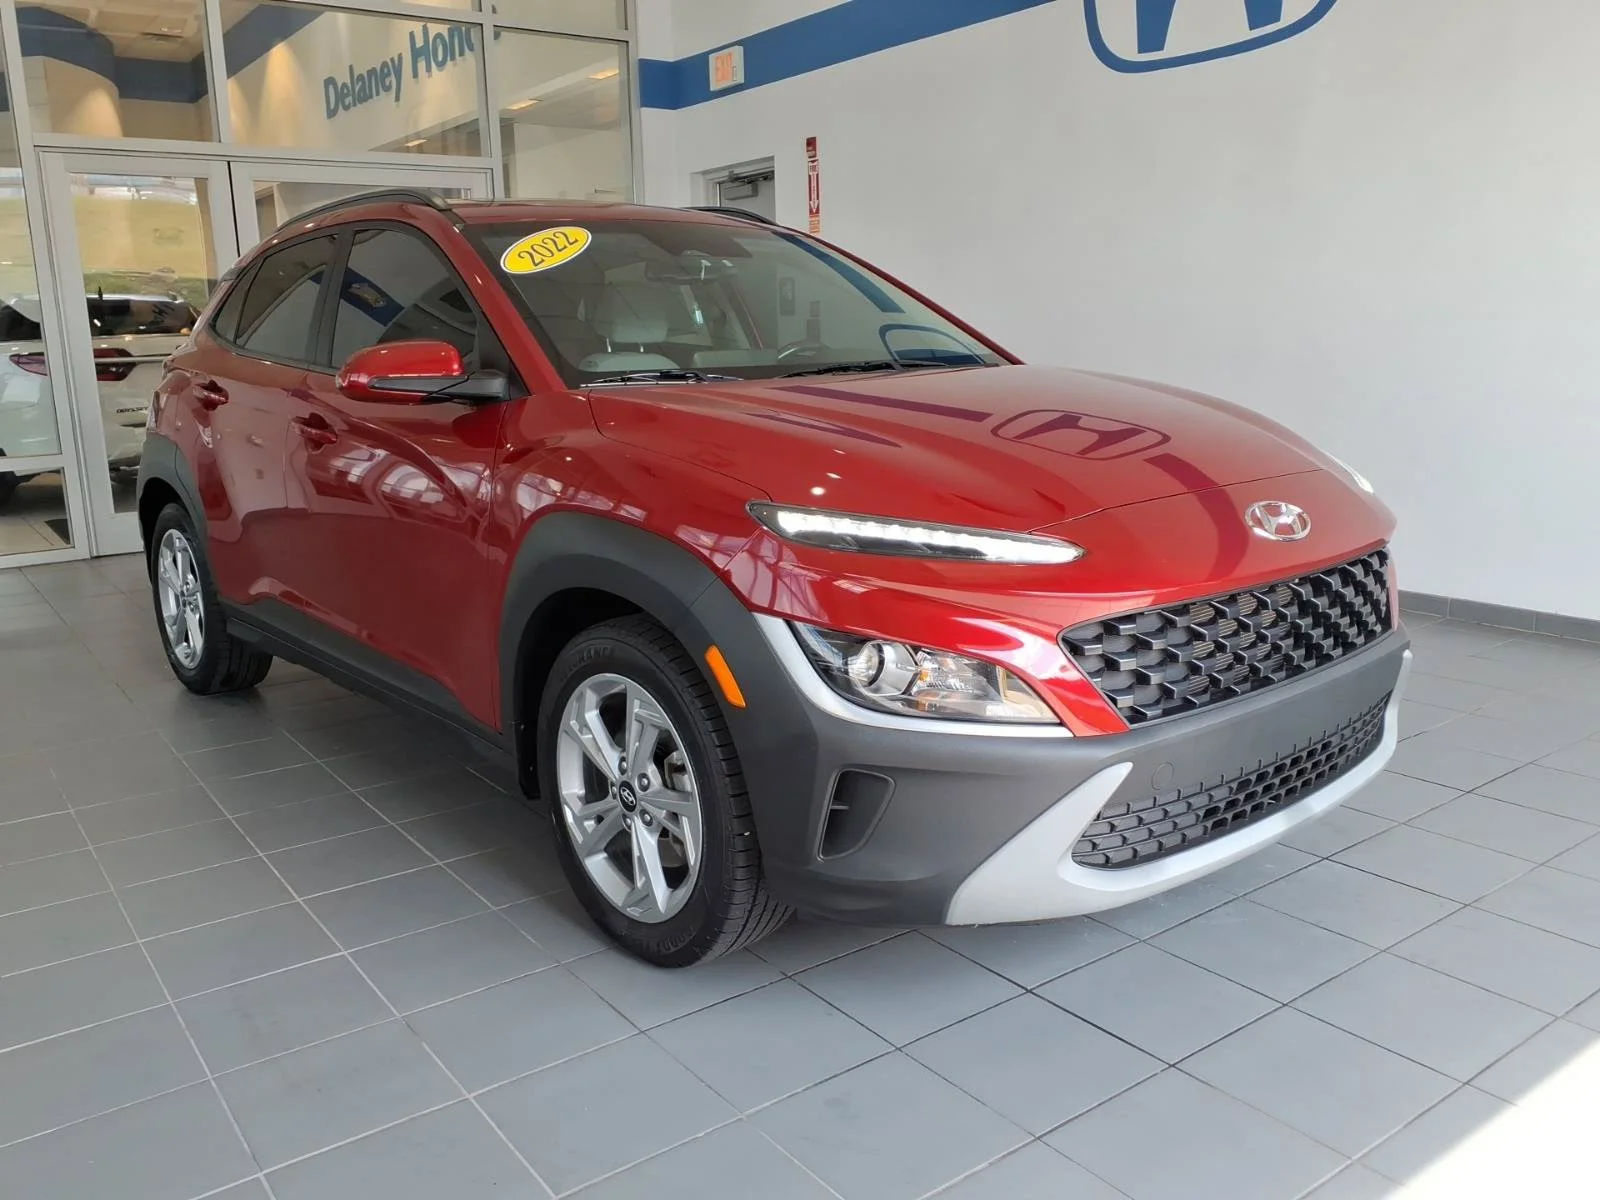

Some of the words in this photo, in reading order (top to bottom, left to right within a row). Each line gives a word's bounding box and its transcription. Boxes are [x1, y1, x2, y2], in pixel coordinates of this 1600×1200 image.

[323, 53, 403, 119] Delaney
[409, 20, 478, 80] Hon
[518, 231, 579, 267] 2022
